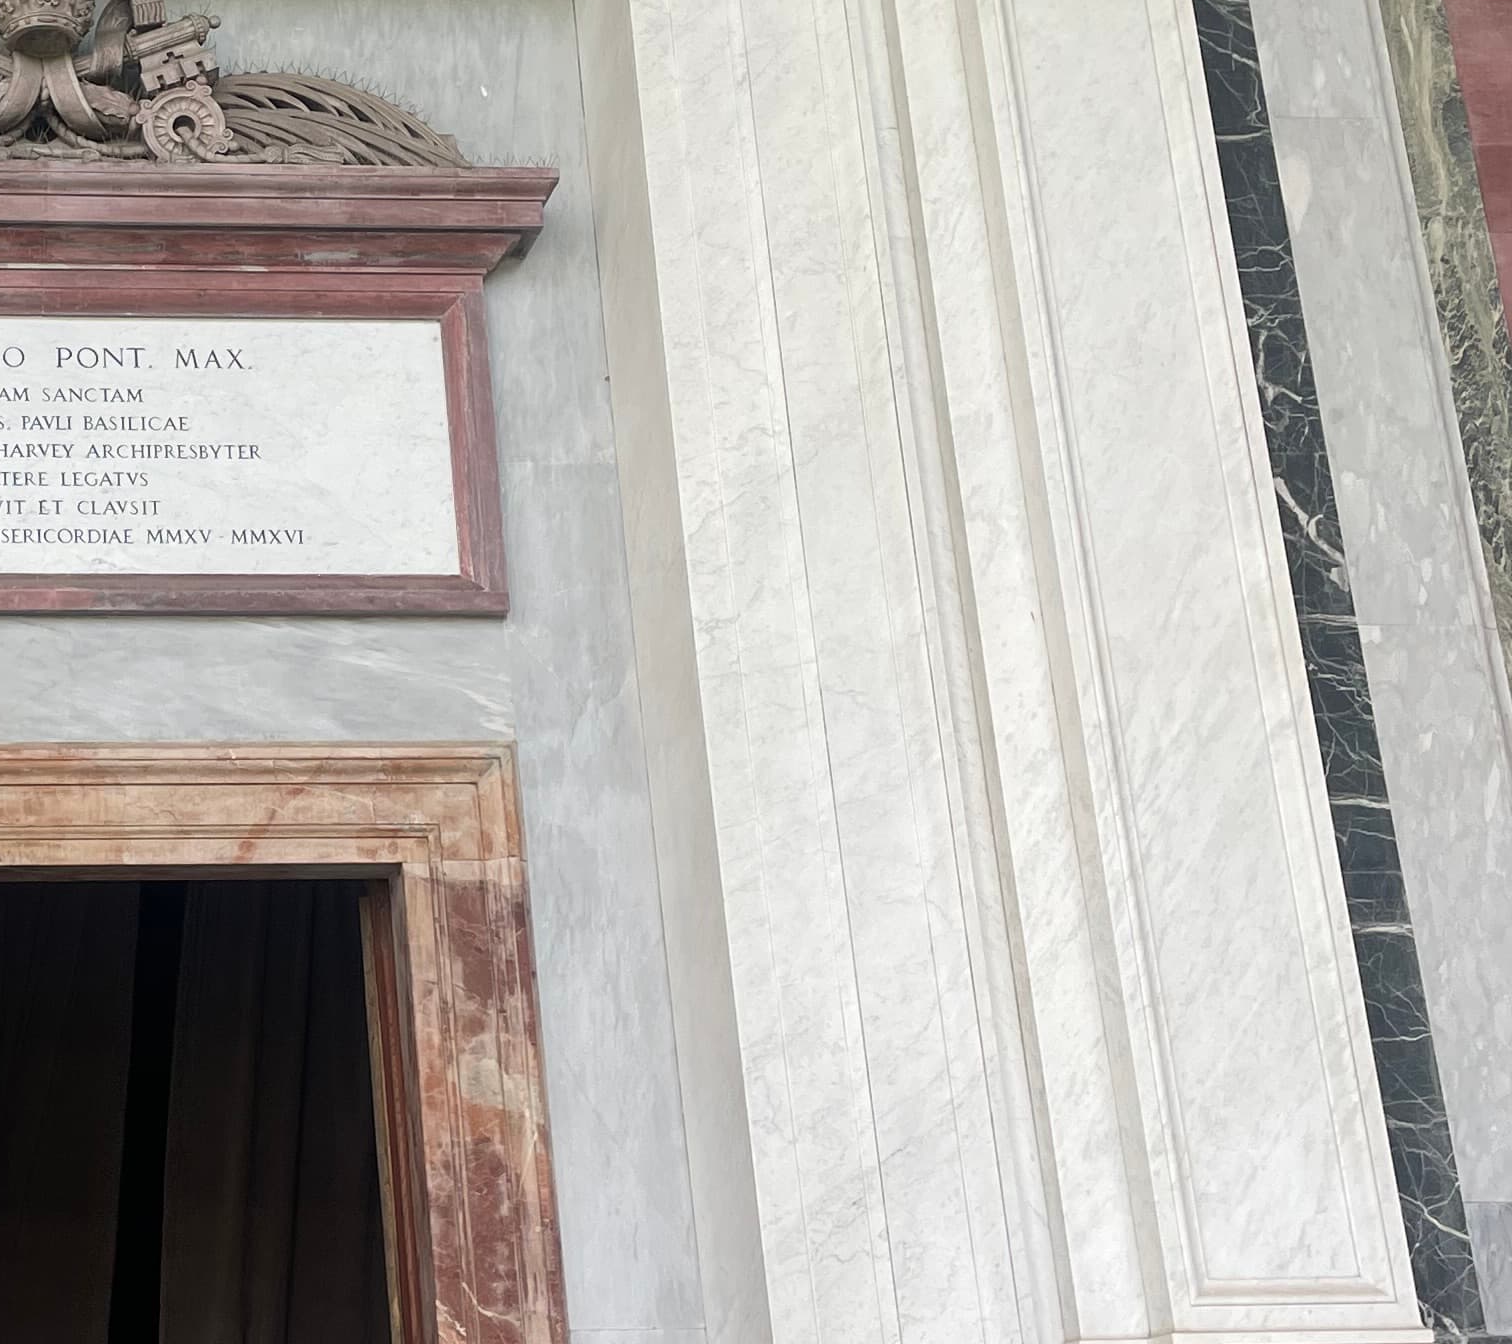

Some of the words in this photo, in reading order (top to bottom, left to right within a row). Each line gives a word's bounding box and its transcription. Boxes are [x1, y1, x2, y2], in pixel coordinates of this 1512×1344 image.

[55, 346, 153, 369] PONT.
[174, 347, 253, 370] MAX.
[41, 387, 145, 403] SANCTAM
[21, 415, 72, 431] PAVLI
[82, 415, 190, 431] BASILICAE
[86, 443, 263, 460] ARCHIPRESBYTER
[60, 471, 149, 487] LEGATVS
[38, 499, 64, 516] ET
[76, 499, 161, 516] CLAVSIT
[145, 528, 213, 545] MMXV
[231, 528, 304, 545] MMXVI
